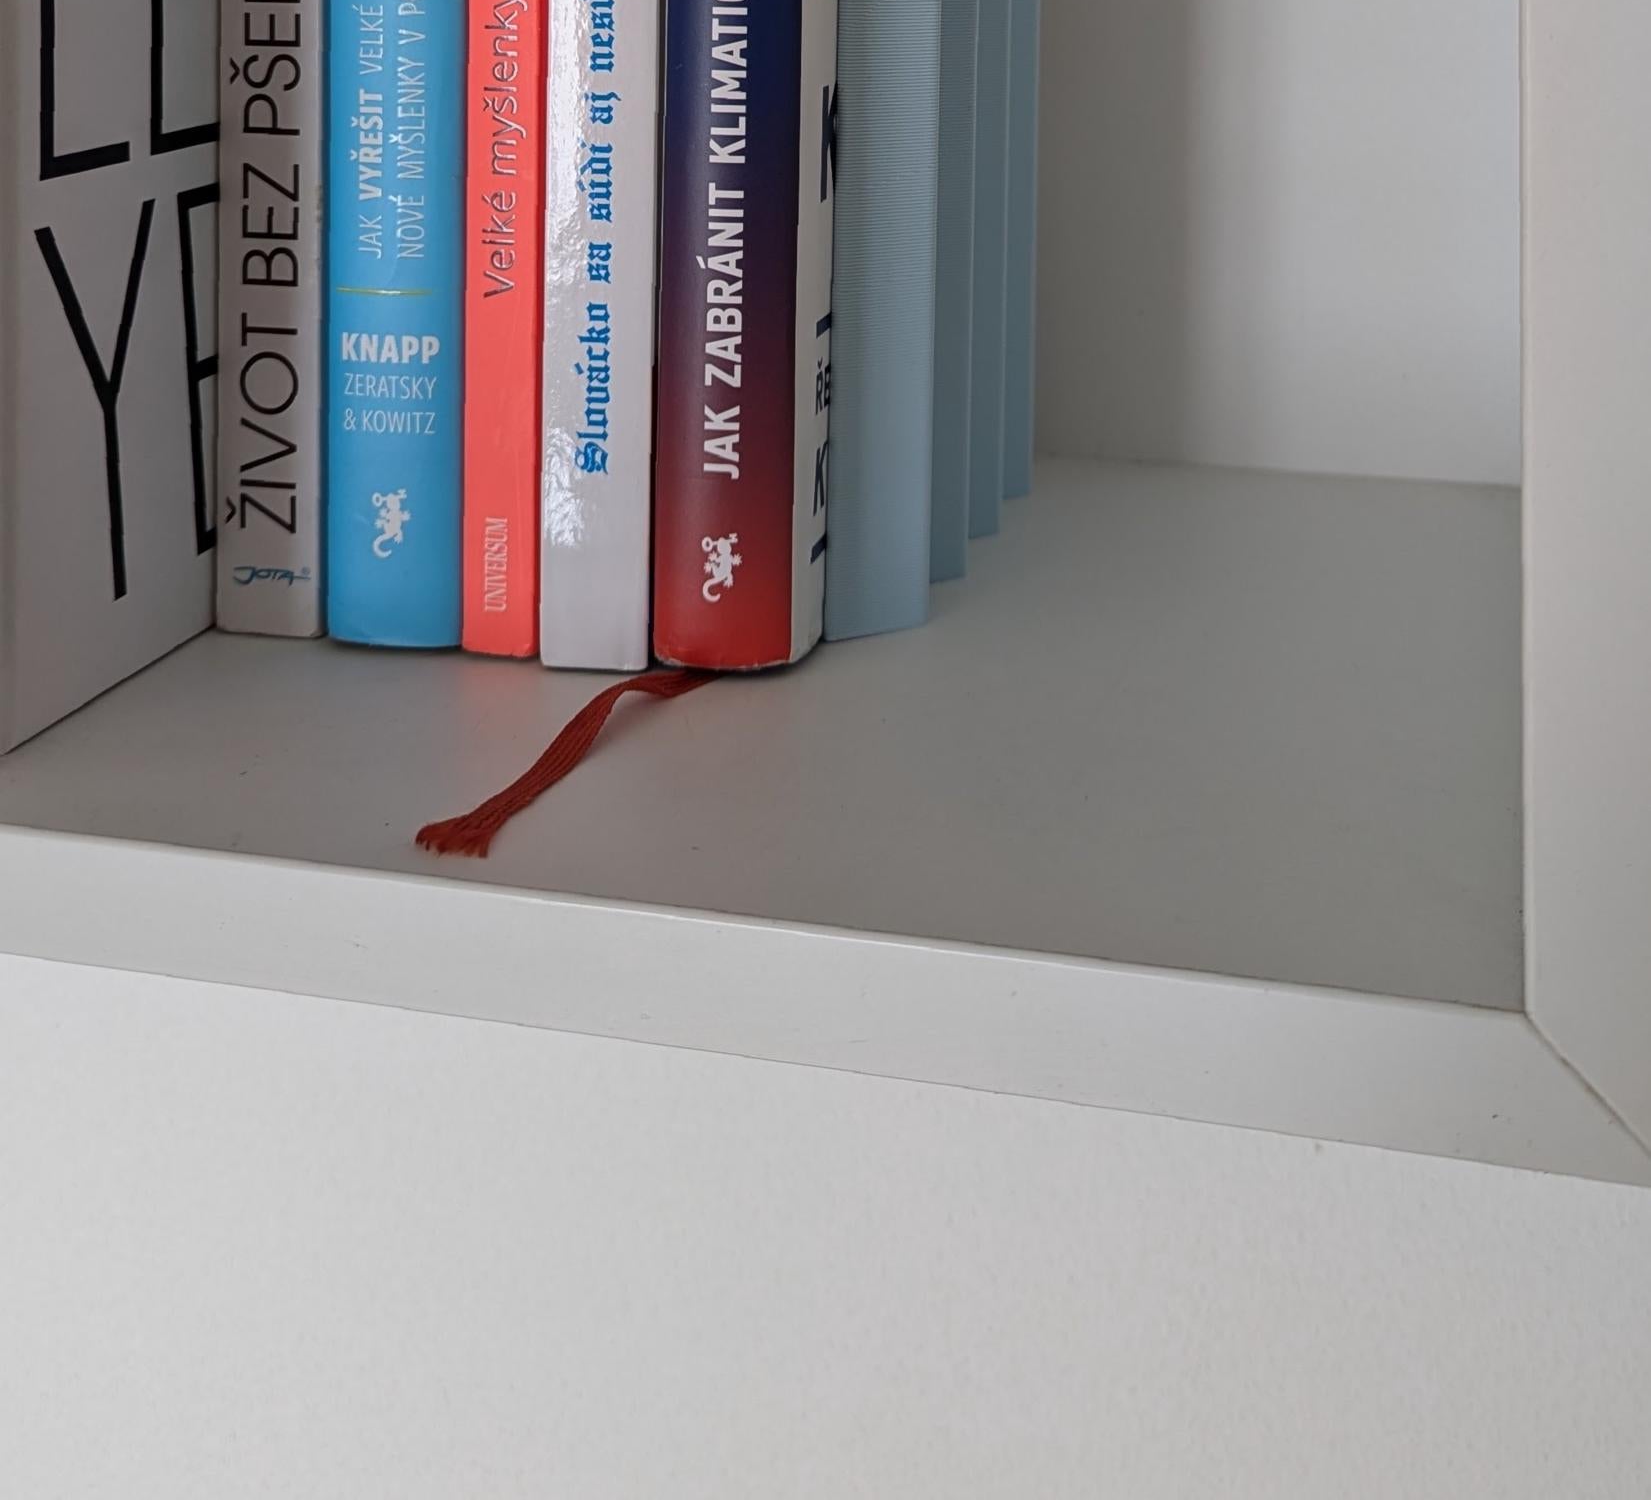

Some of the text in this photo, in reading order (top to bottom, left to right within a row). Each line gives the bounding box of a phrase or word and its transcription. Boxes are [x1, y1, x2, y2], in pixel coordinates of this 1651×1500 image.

[352, 3, 384, 75] VELKÉ
[398, 29, 425, 45] V
[349, 88, 383, 201] VYŘEŠIT
[388, 56, 425, 180] MYŠLENKY
[585, 91, 622, 125] aj
[242, 162, 300, 287] BEZ
[358, 214, 383, 259] JAK
[388, 195, 425, 259] NOVÉ
[481, 190, 517, 298] Velké
[587, 241, 612, 285] sa
[696, 182, 745, 389] ZABRÁNIT
[341, 332, 440, 365] KNAPP
[225, 312, 299, 534] ŽIVOT
[343, 407, 437, 435] & KOWITZ
[344, 373, 438, 400] ZERATSKY
[574, 300, 611, 476] Slovácko
[703, 405, 741, 480] JAK
[484, 516, 509, 612] UNIVERSUM
